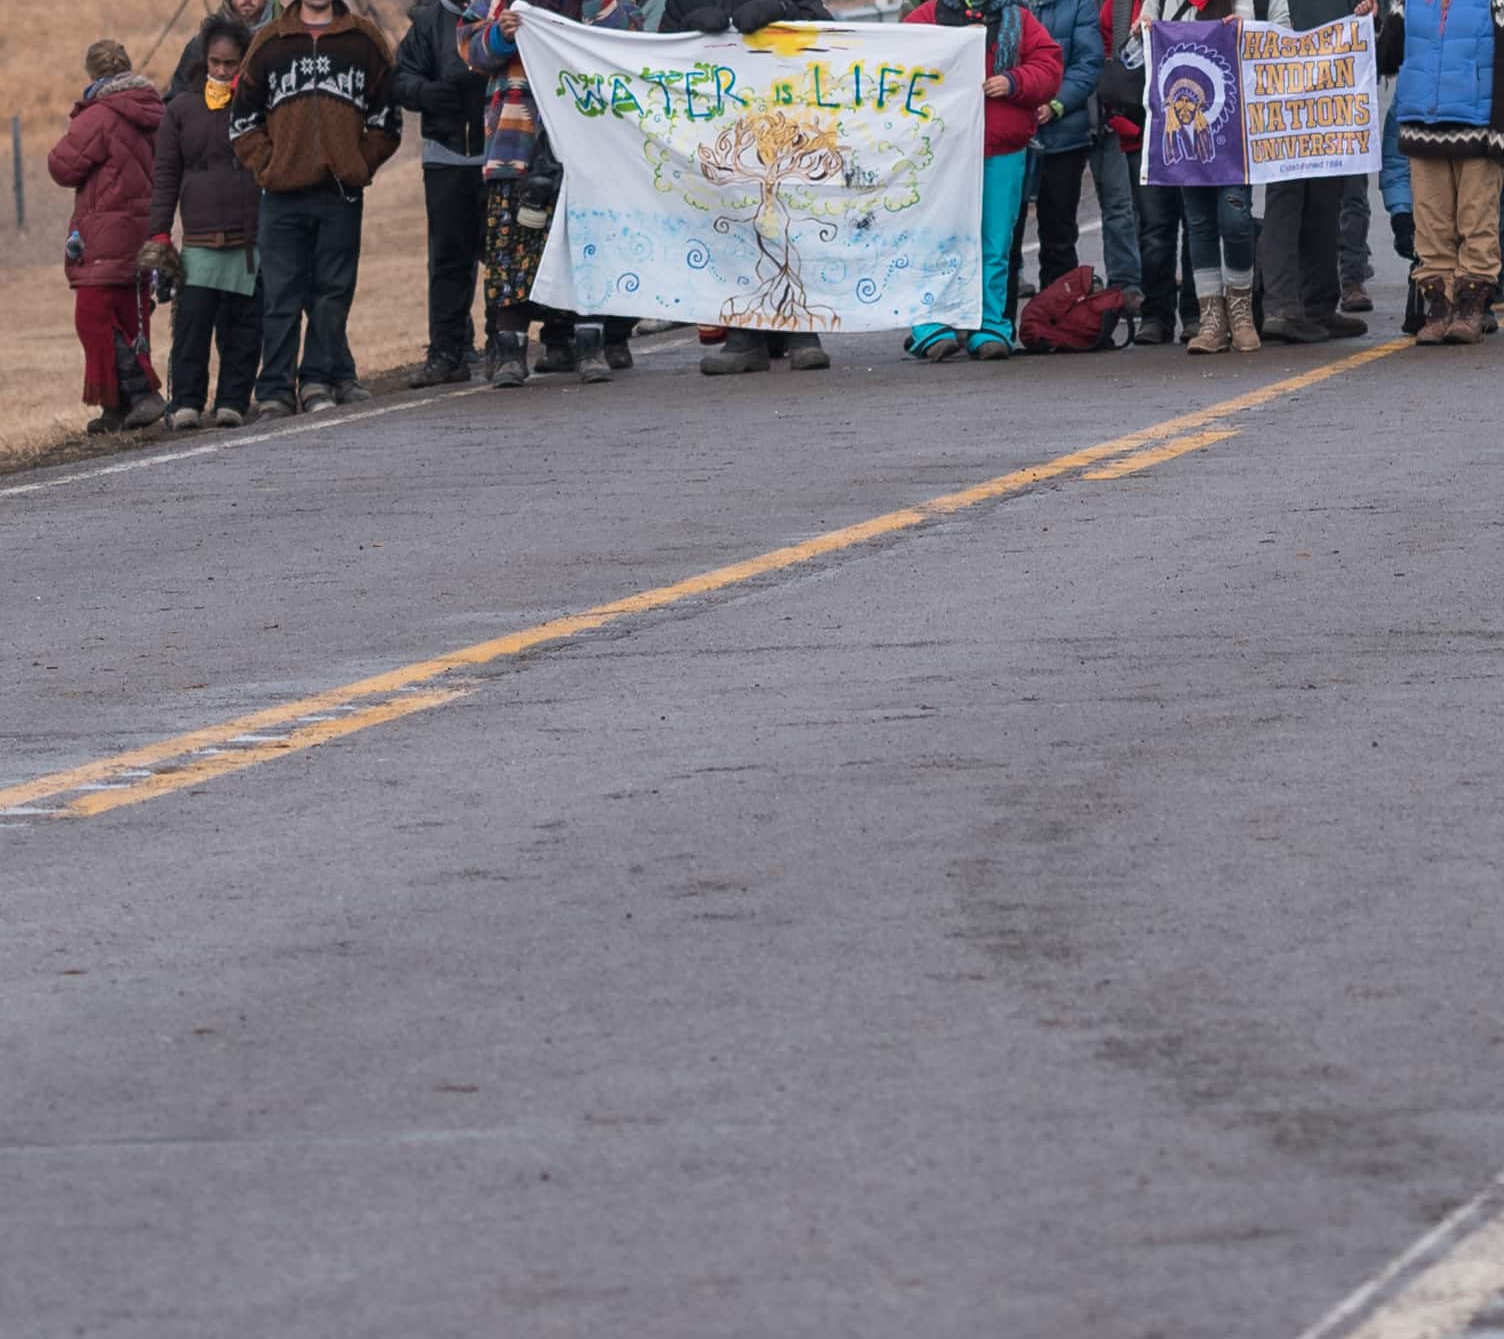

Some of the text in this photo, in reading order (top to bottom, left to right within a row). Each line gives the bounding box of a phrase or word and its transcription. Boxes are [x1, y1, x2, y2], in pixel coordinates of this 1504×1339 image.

[1243, 21, 1367, 60] HASKELL
[564, 65, 750, 119] WATER
[814, 64, 939, 119] LIFE
[1254, 57, 1355, 95] INDIAN
[1247, 94, 1370, 134] NATIONS
[1250, 130, 1370, 163] UNIVERSITY
